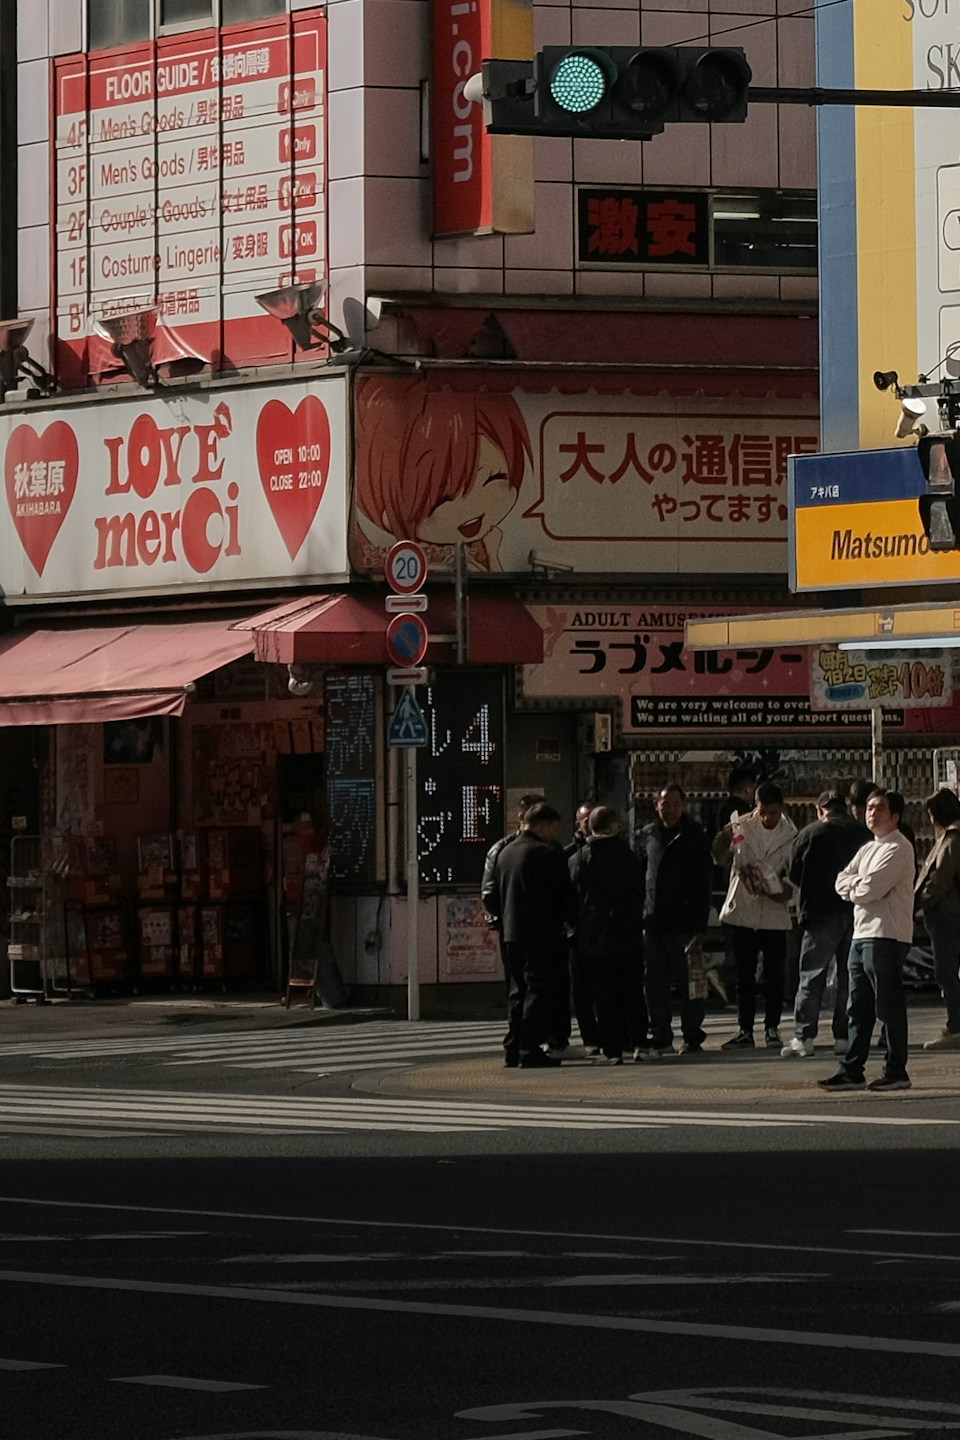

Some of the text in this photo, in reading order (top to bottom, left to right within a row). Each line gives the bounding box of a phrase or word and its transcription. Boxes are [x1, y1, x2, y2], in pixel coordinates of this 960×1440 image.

[106, 70, 152, 101] FLOOR
[156, 61, 199, 93] GUIDE
[101, 114, 137, 141] Men's
[141, 105, 184, 133] Goods
[68, 163, 86, 197] 3F
[101, 159, 137, 187] Men's
[142, 152, 185, 180] Goods
[162, 195, 206, 223] Goods
[587, 196, 698, 256] 激安
[300, 232, 313, 250] OK
[69, 255, 86, 287] 1F
[101, 253, 161, 279] Costume
[167, 240, 221, 272] Lingerie
[104, 412, 229, 499] LOVE
[274, 444, 321, 466] OPEN 10:00
[13, 459, 66, 500] 秋葉原
[269, 470, 322, 491] CLOSE 22:00
[810, 485, 840, 500] アキバ店
[15, 500, 62, 518] AKIHABARA
[651, 493, 778, 523] やってます
[396, 556, 418, 580] 20
[571, 612, 630, 627] ADULT
[636, 699, 655, 711] We
[657, 701, 678, 711] are
[681, 701, 708, 713] very
[711, 699, 764, 711] welcome
[767, 700, 781, 711] to
[636, 712, 655, 723] We
[657, 713, 678, 723] are
[681, 712, 728, 725] waiting
[731, 712, 748, 723] all
[750, 712, 763, 723] of
[766, 713, 795, 725] your
[798, 713, 838, 725] export
